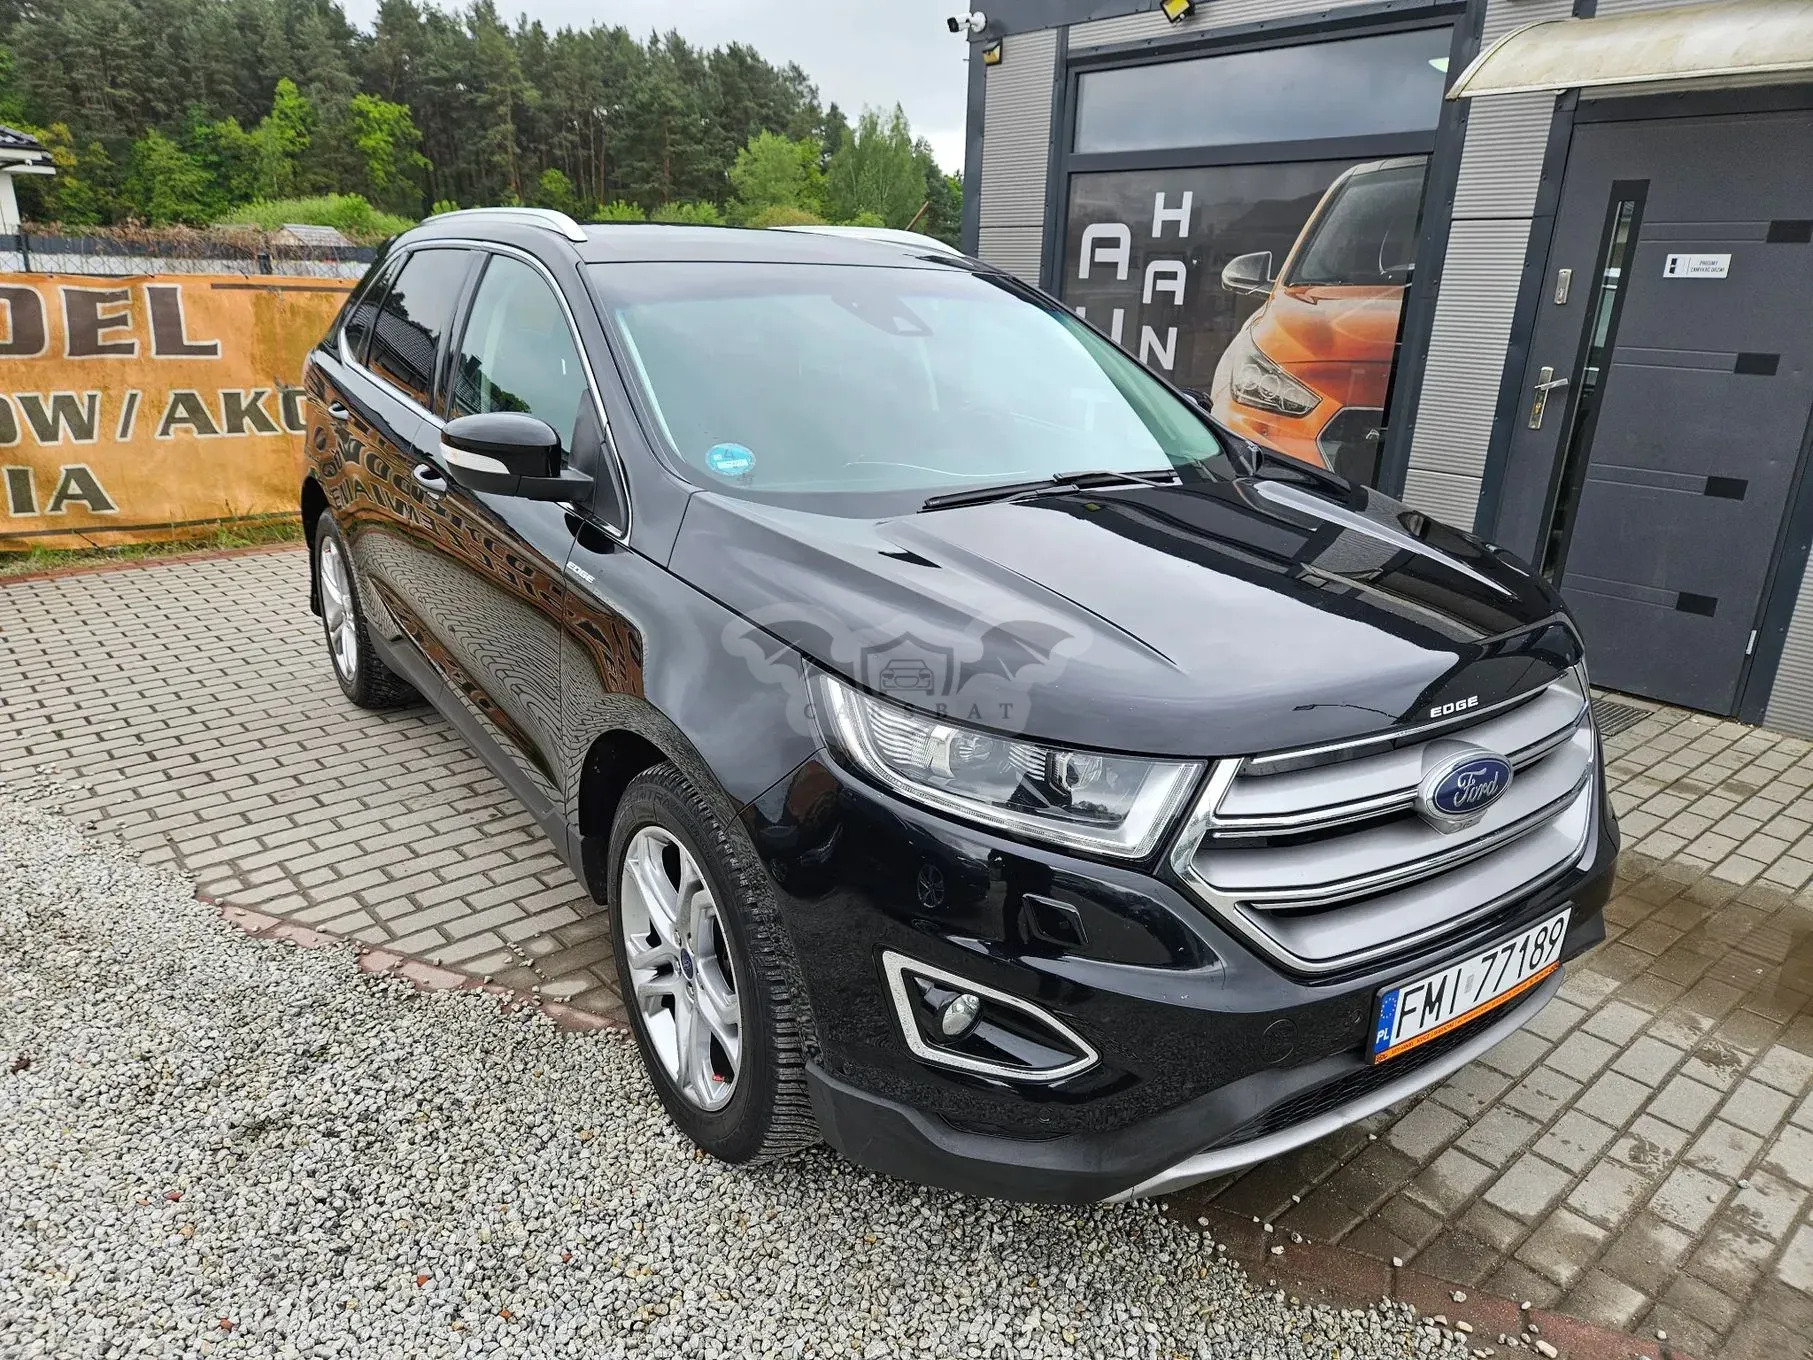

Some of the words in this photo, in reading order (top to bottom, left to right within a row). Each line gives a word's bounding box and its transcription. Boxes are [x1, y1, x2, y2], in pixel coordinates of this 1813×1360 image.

[566, 561, 596, 584] EDGE
[1430, 695, 1479, 718] EDGE
[1453, 767, 1499, 807] Ford
[1396, 968, 1463, 1039] FMI
[1473, 917, 1566, 1003] 77189
[1376, 1028, 1390, 1044] PL
